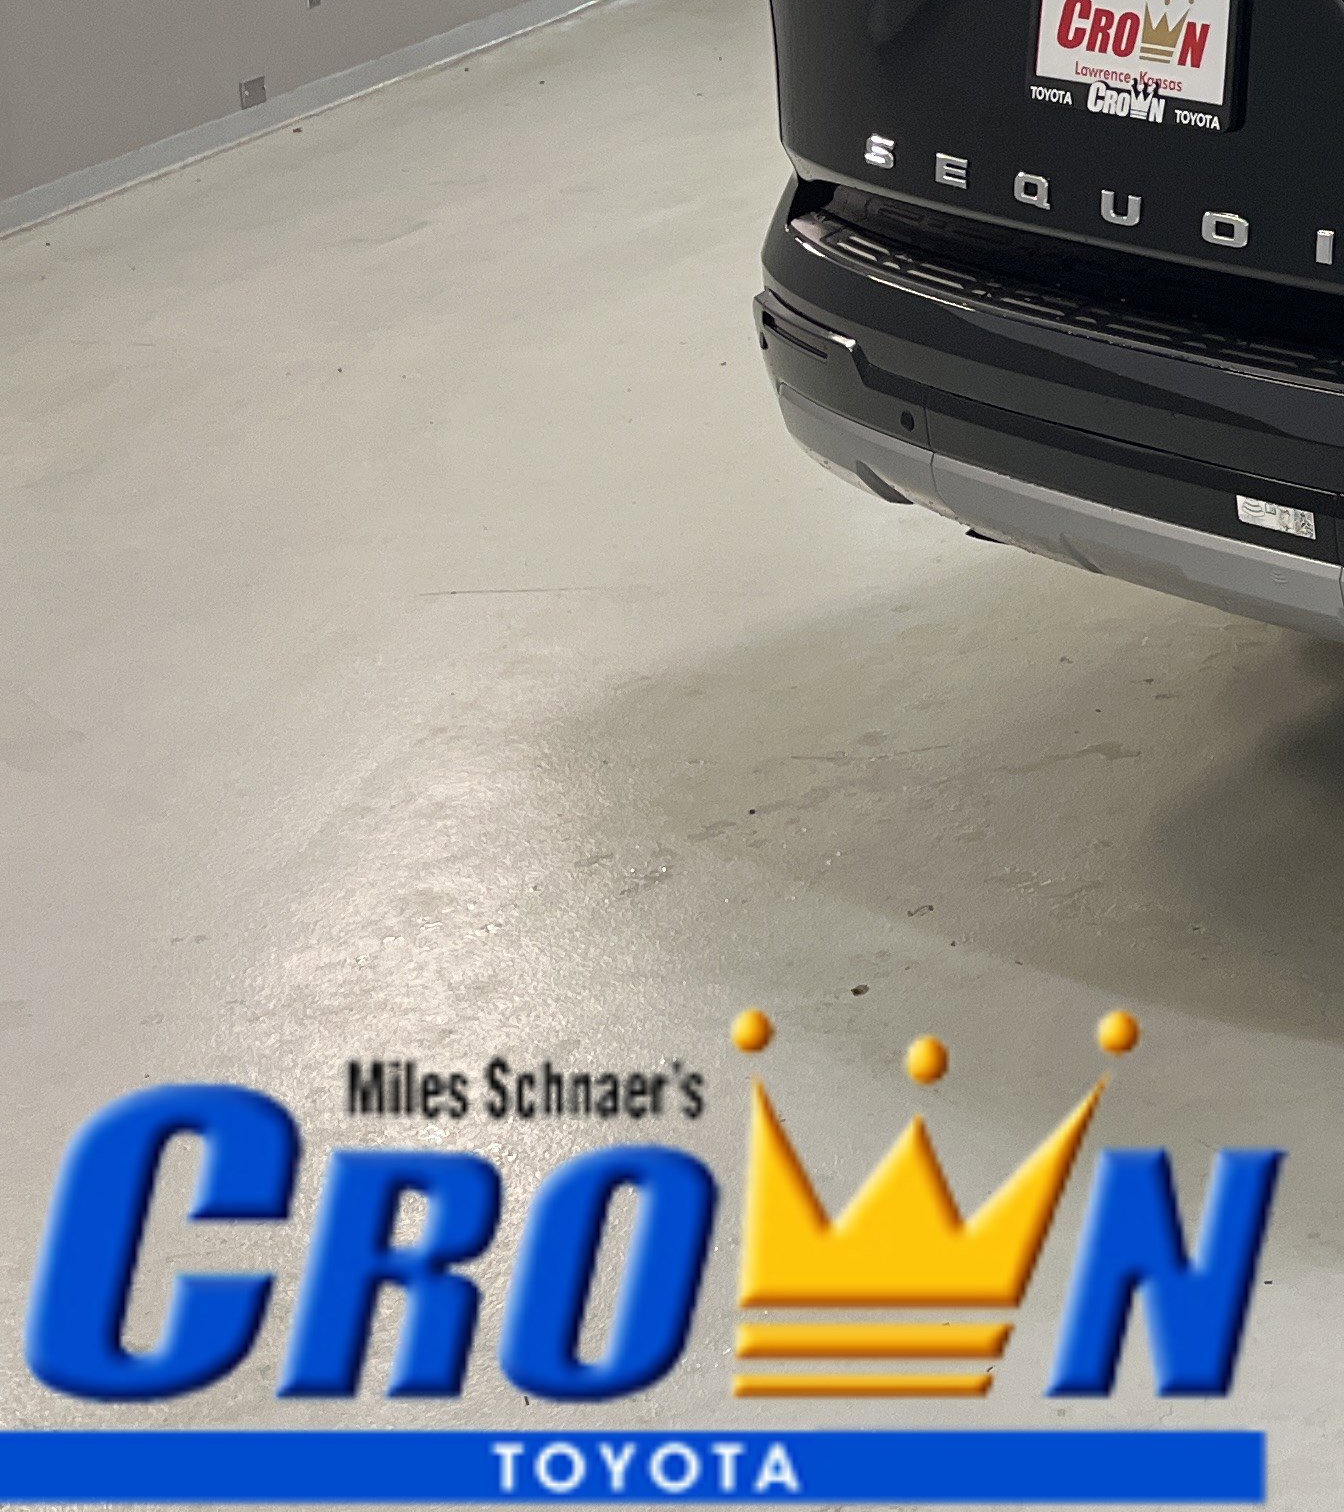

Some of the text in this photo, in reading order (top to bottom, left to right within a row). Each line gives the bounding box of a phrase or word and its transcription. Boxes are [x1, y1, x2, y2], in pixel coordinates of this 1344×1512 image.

[1139, 71, 1183, 92] Kansas
[1030, 85, 1073, 106] TOYOTA
[1174, 109, 1221, 131] TOYOTA
